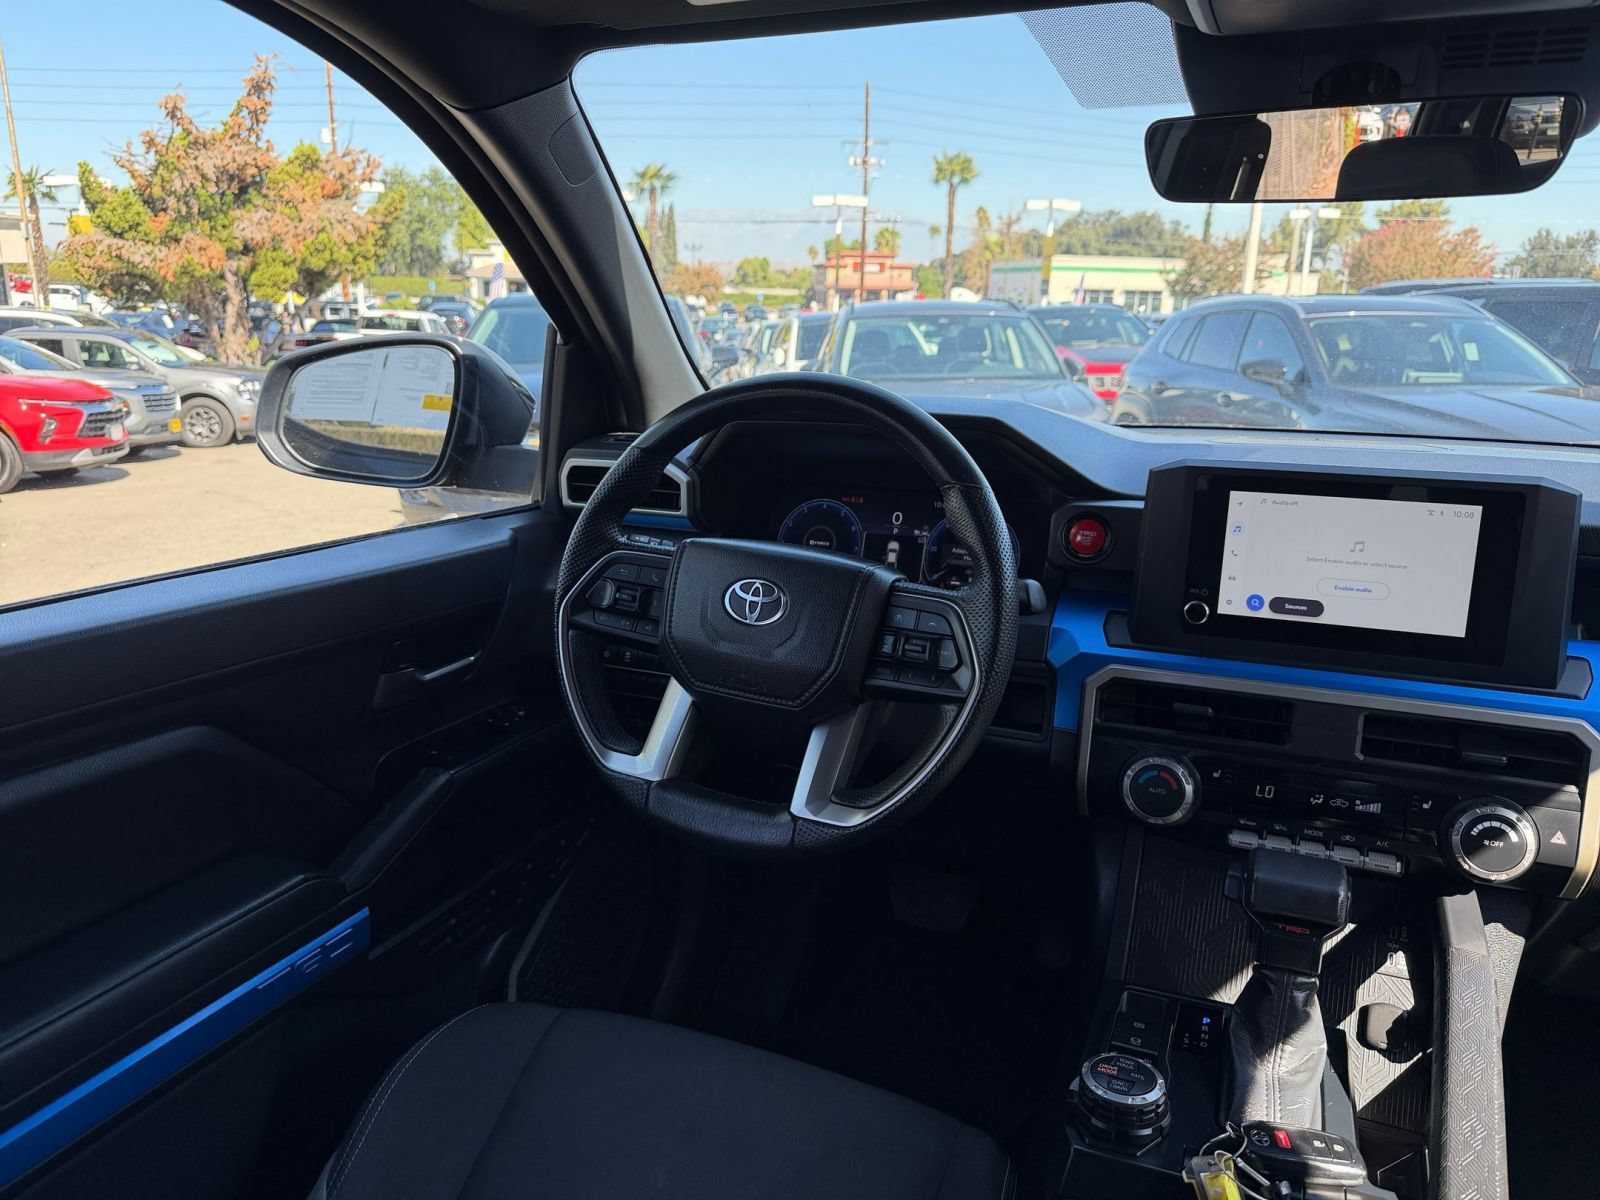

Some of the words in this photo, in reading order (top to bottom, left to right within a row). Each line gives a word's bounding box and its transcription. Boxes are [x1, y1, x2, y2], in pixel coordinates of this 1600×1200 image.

[892, 511, 903, 526] 0
[1305, 555, 1323, 563] Select
[1324, 556, 1344, 565] Enable
[1345, 558, 1362, 567] audio
[1370, 561, 1387, 569] select
[1388, 563, 1409, 571] source
[1334, 584, 1354, 592] Enable
[1355, 585, 1373, 593] audio
[1284, 603, 1308, 611] Sources
[1148, 787, 1167, 795] AUTO
[1303, 829, 1324, 837] MODE
[1376, 840, 1390, 848] A/C
[1490, 841, 1504, 849] OFF
[1097, 1067, 1117, 1075] MODE
[1099, 1063, 1119, 1071] DRIVE
